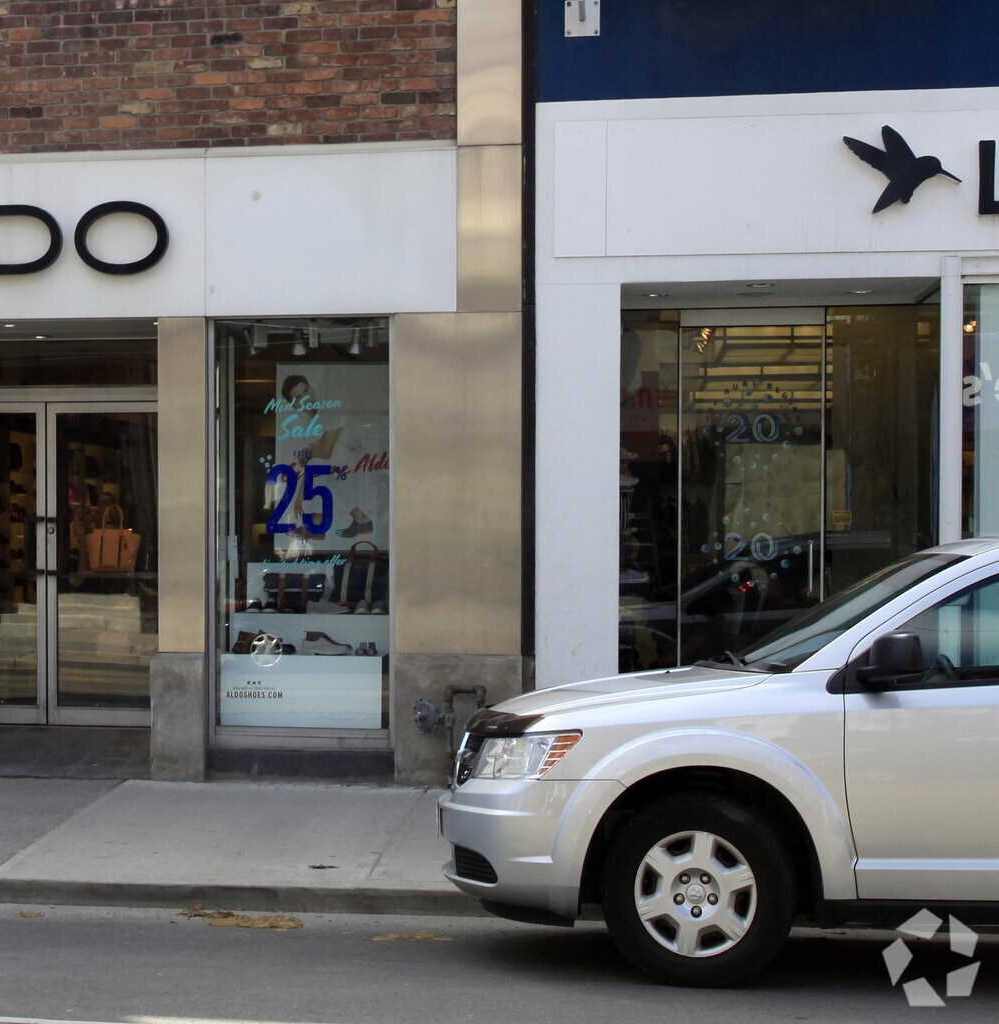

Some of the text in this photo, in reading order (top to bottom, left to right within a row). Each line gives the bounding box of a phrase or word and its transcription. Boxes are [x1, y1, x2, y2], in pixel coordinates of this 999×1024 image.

[264, 394, 344, 414] Mid Season
[277, 413, 326, 442] Sale
[725, 413, 782, 443] 20
[265, 463, 334, 535] 25
[723, 532, 779, 562] 20
[226, 691, 283, 699] ALDOSHOES.COM
